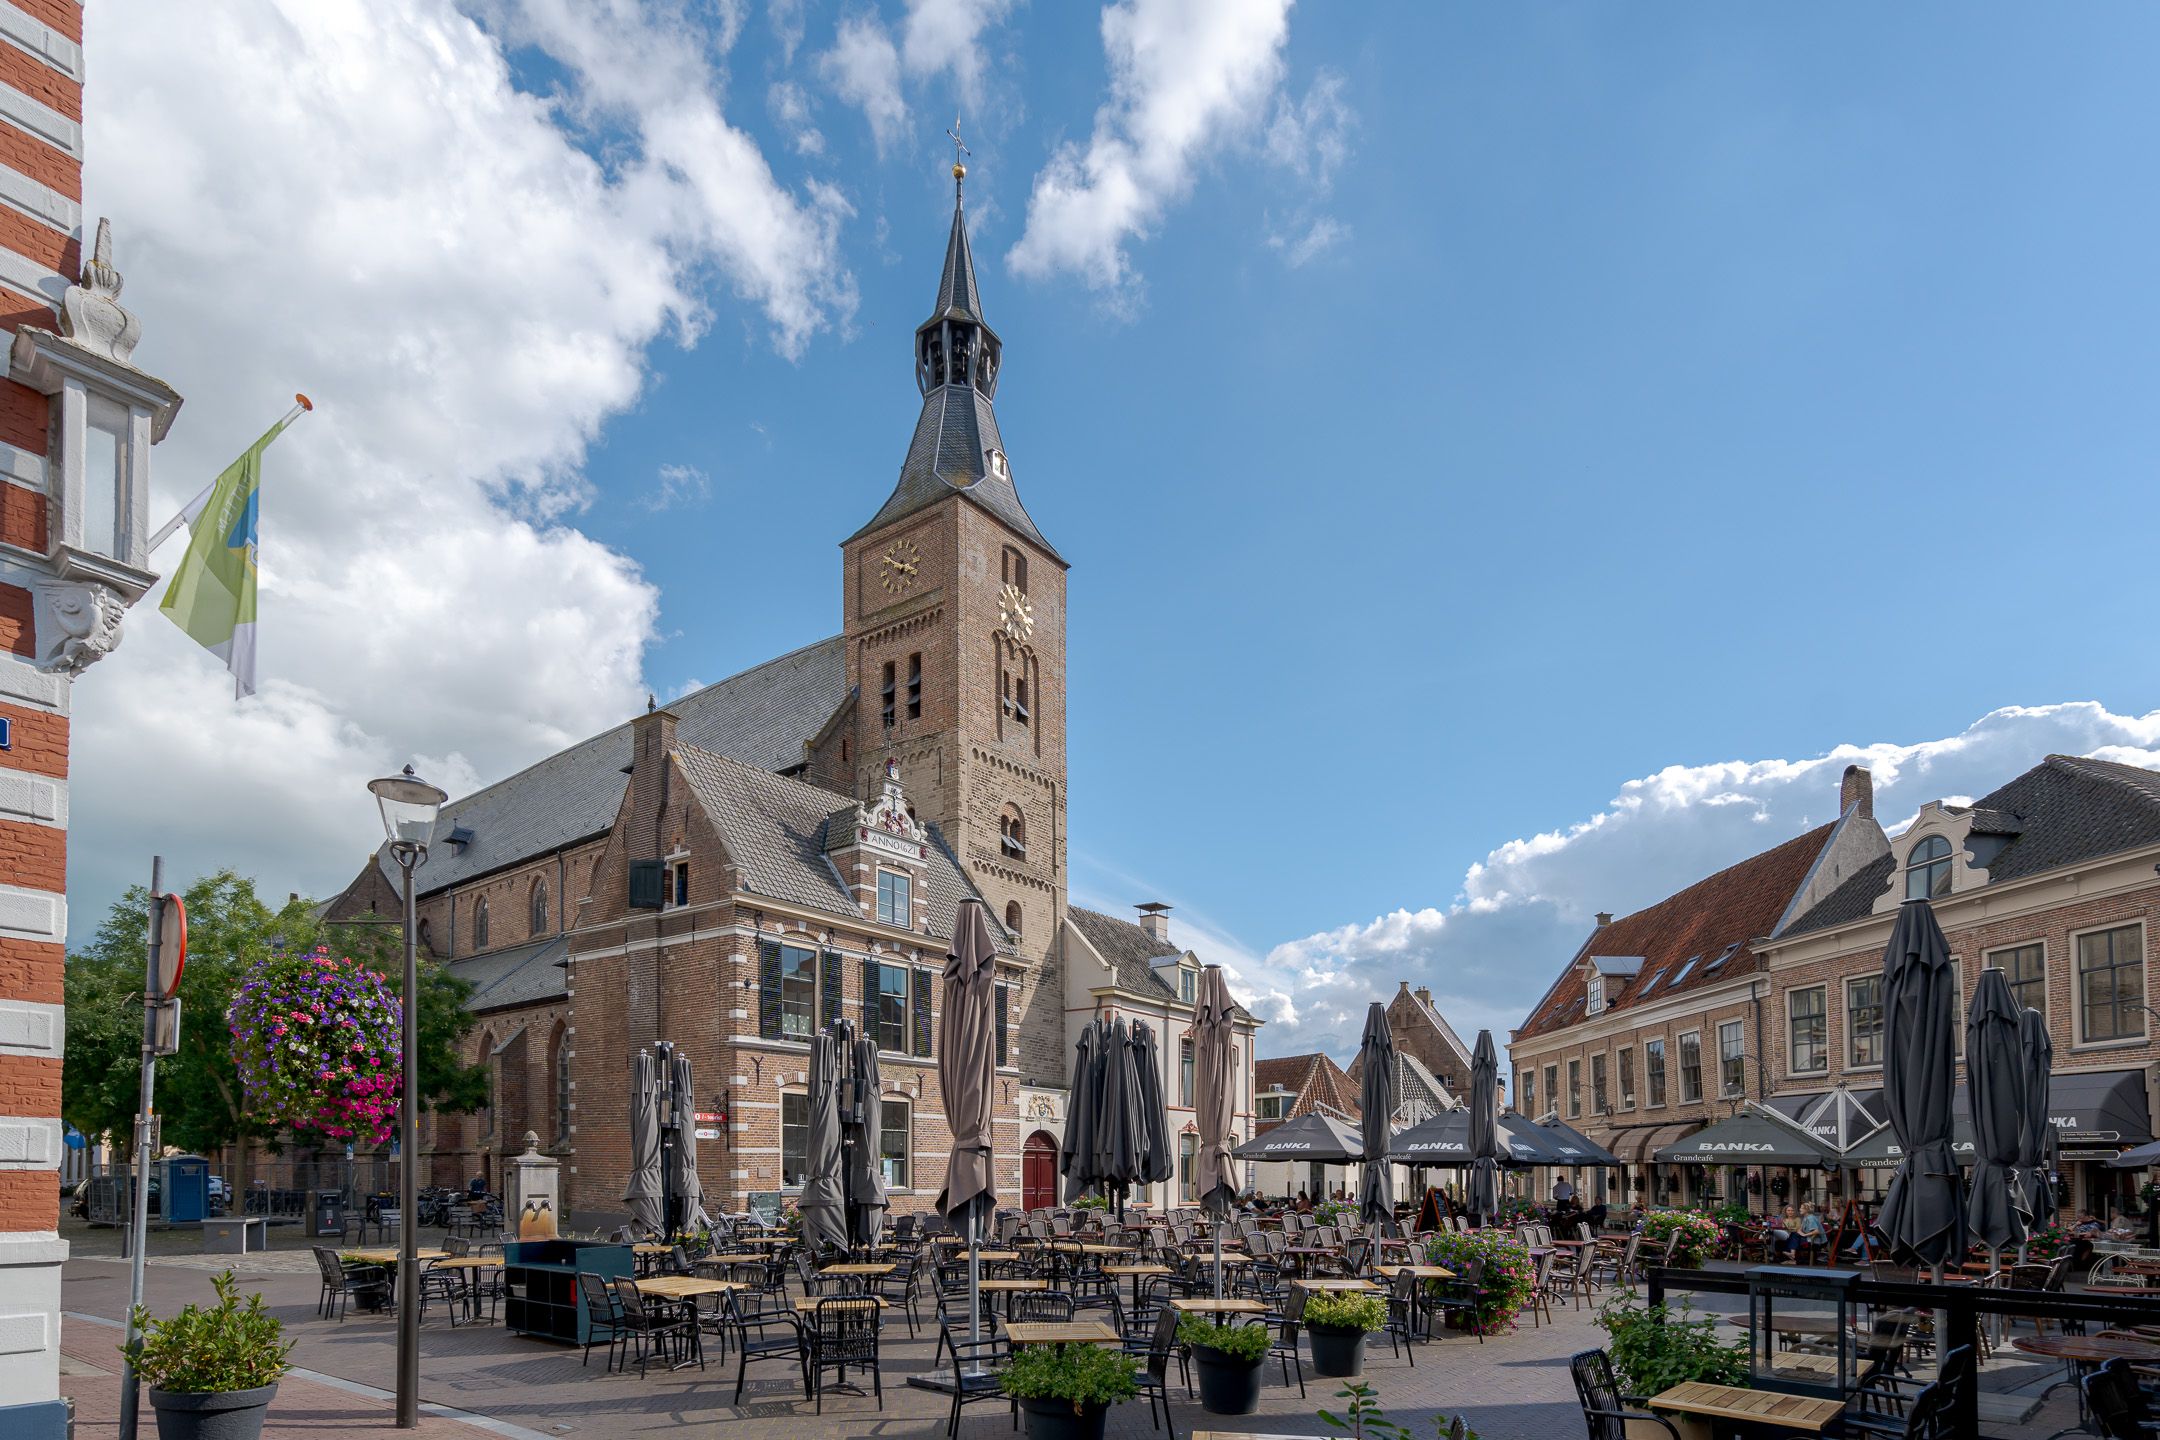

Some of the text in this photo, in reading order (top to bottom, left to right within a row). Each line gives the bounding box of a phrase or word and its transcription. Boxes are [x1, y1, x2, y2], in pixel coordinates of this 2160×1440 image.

[871, 834, 900, 850] ANNO
[1810, 1125, 1837, 1135] ANKA
[1264, 1142, 1312, 1151] BANKA
[1407, 1142, 1464, 1151] BANKA
[1698, 1143, 1775, 1152] BANKA
[1887, 1142, 1975, 1154] BKA
[1673, 1154, 1714, 1163] Grandcafé
